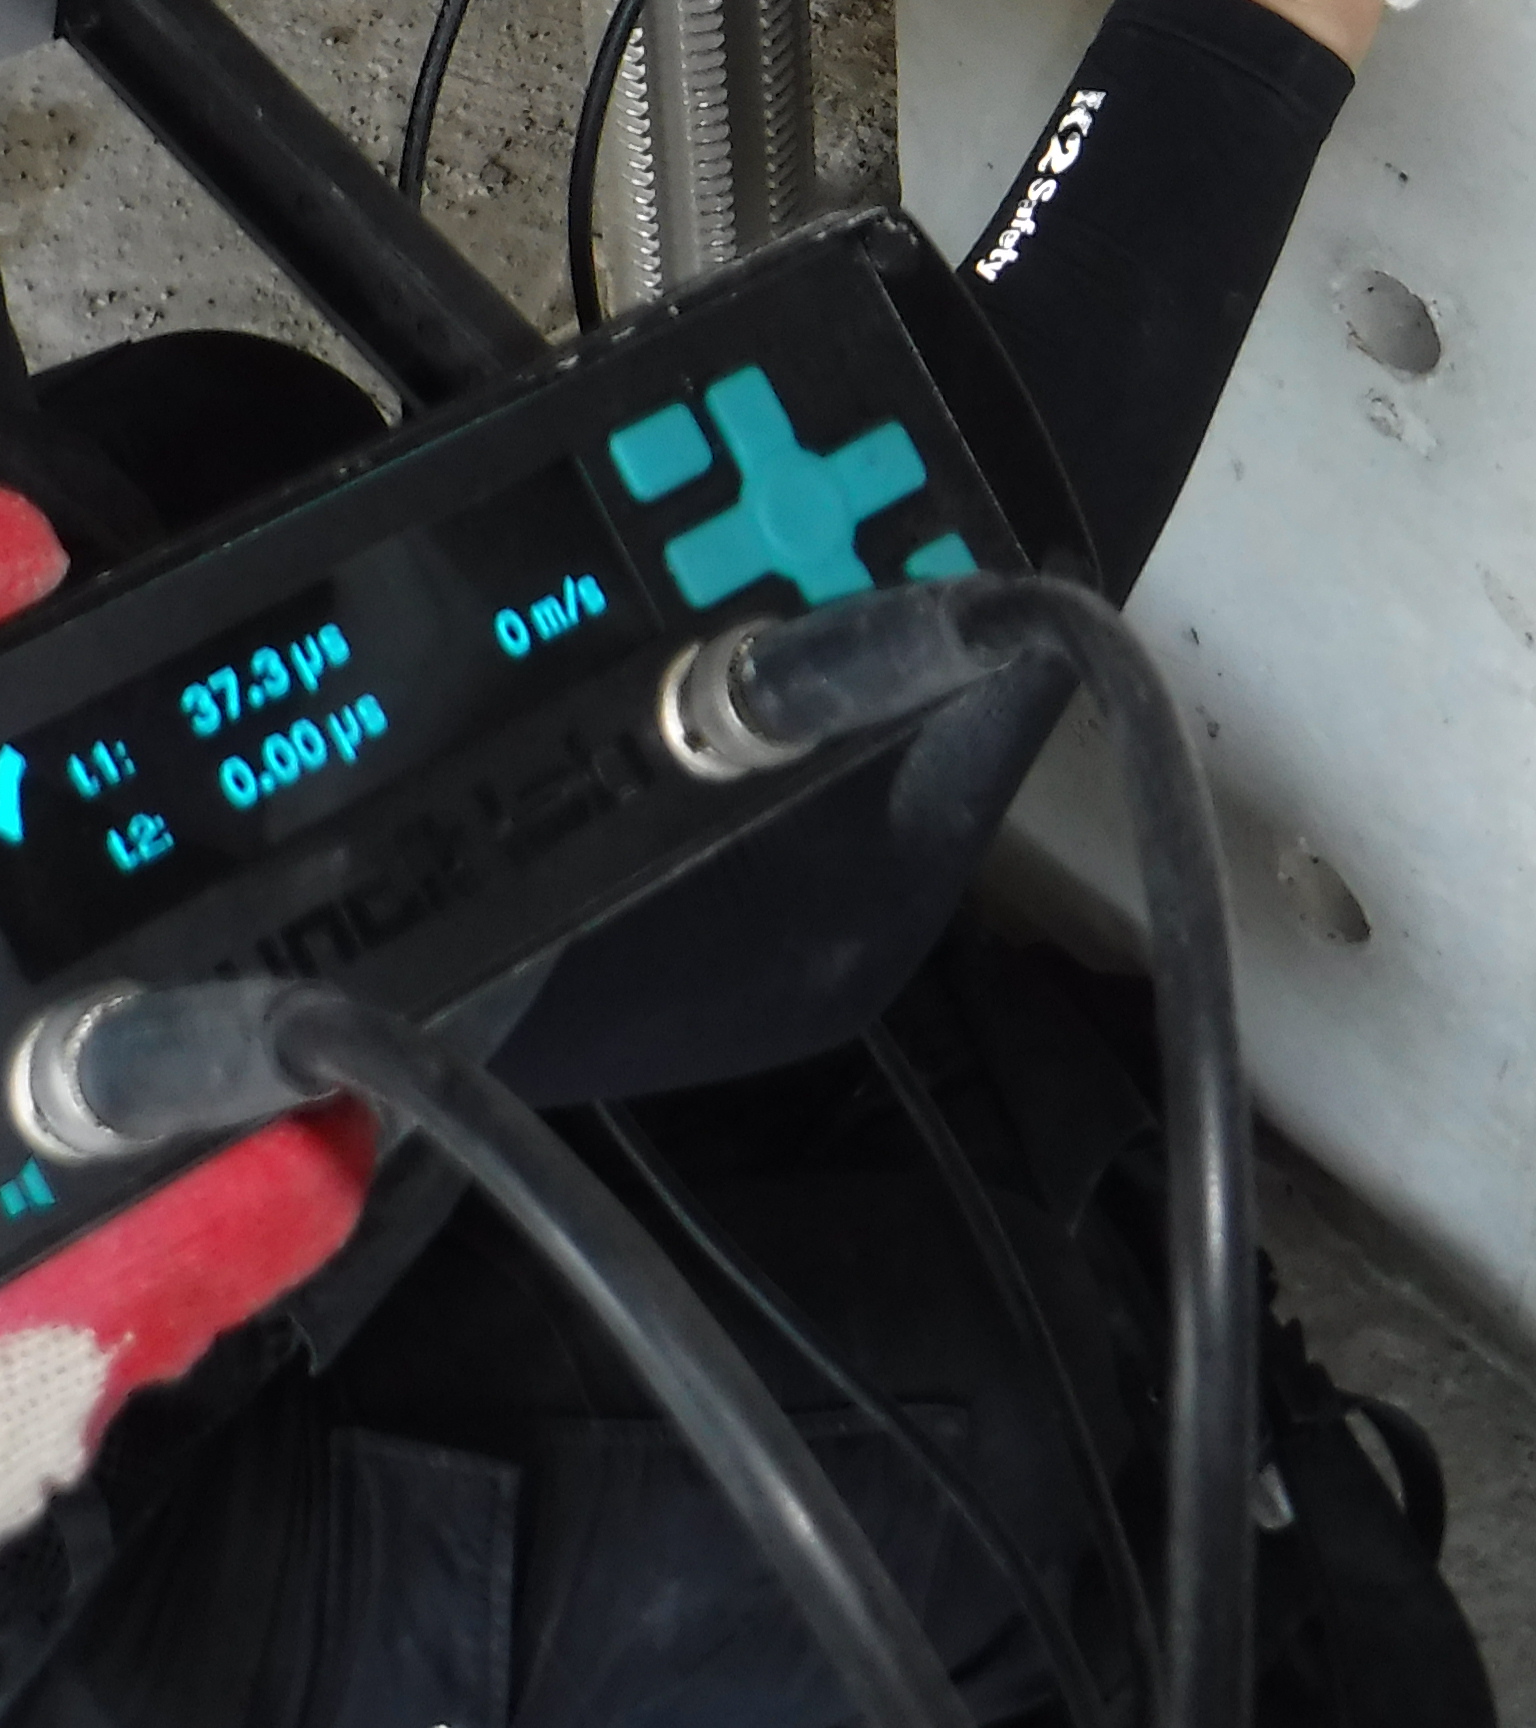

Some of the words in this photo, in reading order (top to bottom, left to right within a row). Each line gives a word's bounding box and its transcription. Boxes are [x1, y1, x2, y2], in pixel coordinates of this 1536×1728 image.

[1037, 89, 1107, 174] K2
[975, 176, 1058, 283] Safety
[493, 606, 531, 659] 0
[530, 573, 608, 641] m/s
[180, 644, 292, 738] 37.3
[217, 717, 328, 810] 0.00
